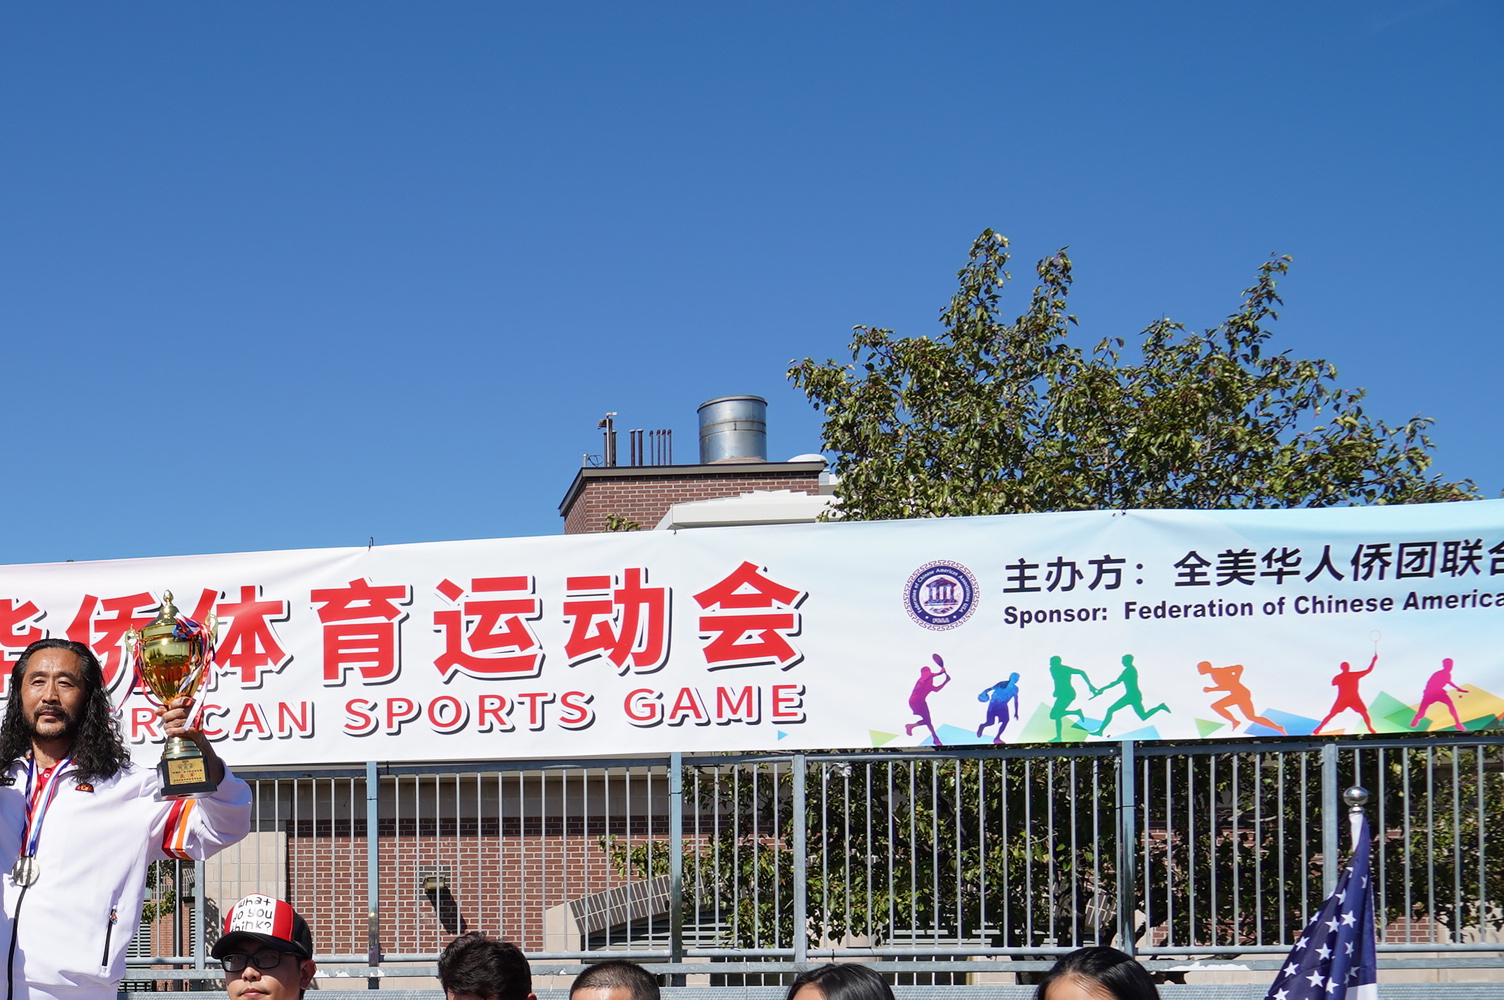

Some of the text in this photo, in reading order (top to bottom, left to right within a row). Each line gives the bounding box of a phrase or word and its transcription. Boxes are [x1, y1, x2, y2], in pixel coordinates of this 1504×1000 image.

[1003, 605, 1108, 629] Sponsor:
[1123, 599, 1254, 620] Federation
[1262, 596, 1286, 616] of
[1293, 594, 1395, 616] Chinese
[343, 690, 594, 735] SPORTS
[623, 683, 803, 726] GAME
